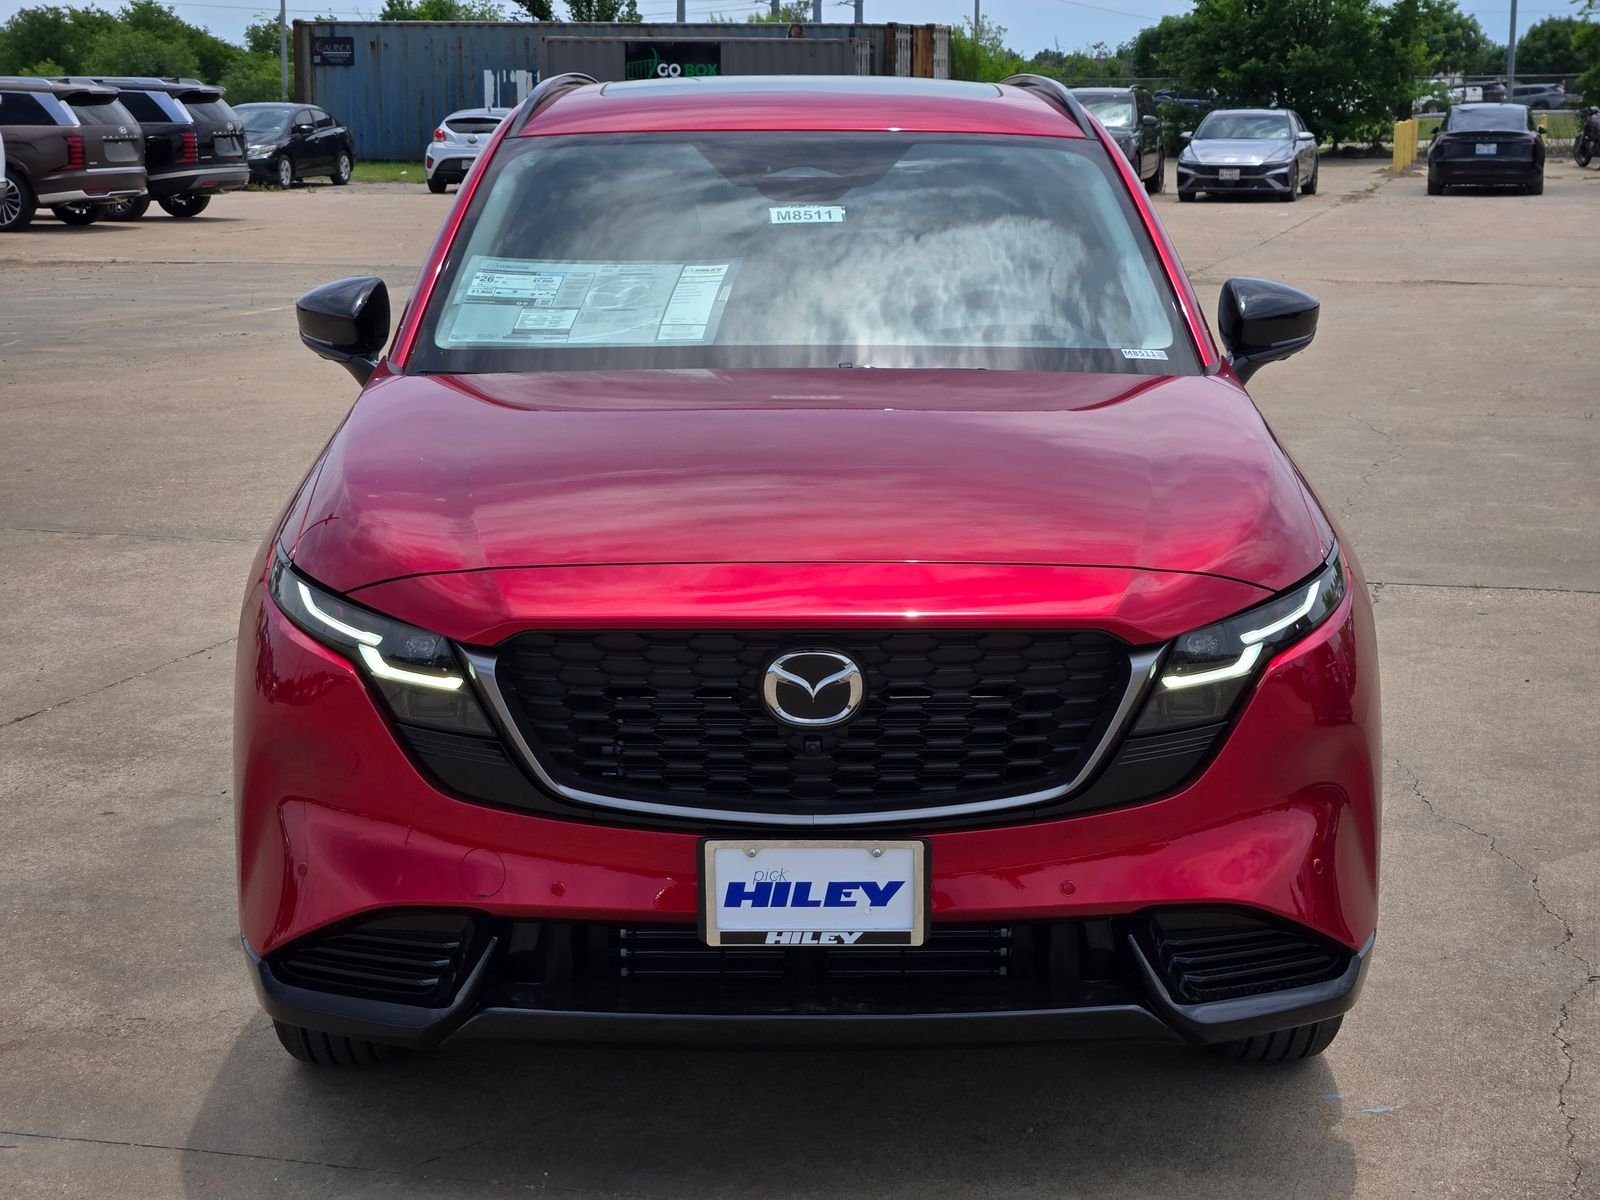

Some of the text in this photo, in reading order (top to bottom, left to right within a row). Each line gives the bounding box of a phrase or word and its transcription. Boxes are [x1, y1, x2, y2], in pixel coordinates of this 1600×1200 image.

[656, 63, 718, 78] GO BOX
[776, 209, 833, 221] M8511
[752, 868, 789, 884] pick
[723, 881, 906, 908] HILEY
[764, 931, 864, 945] HILEY
